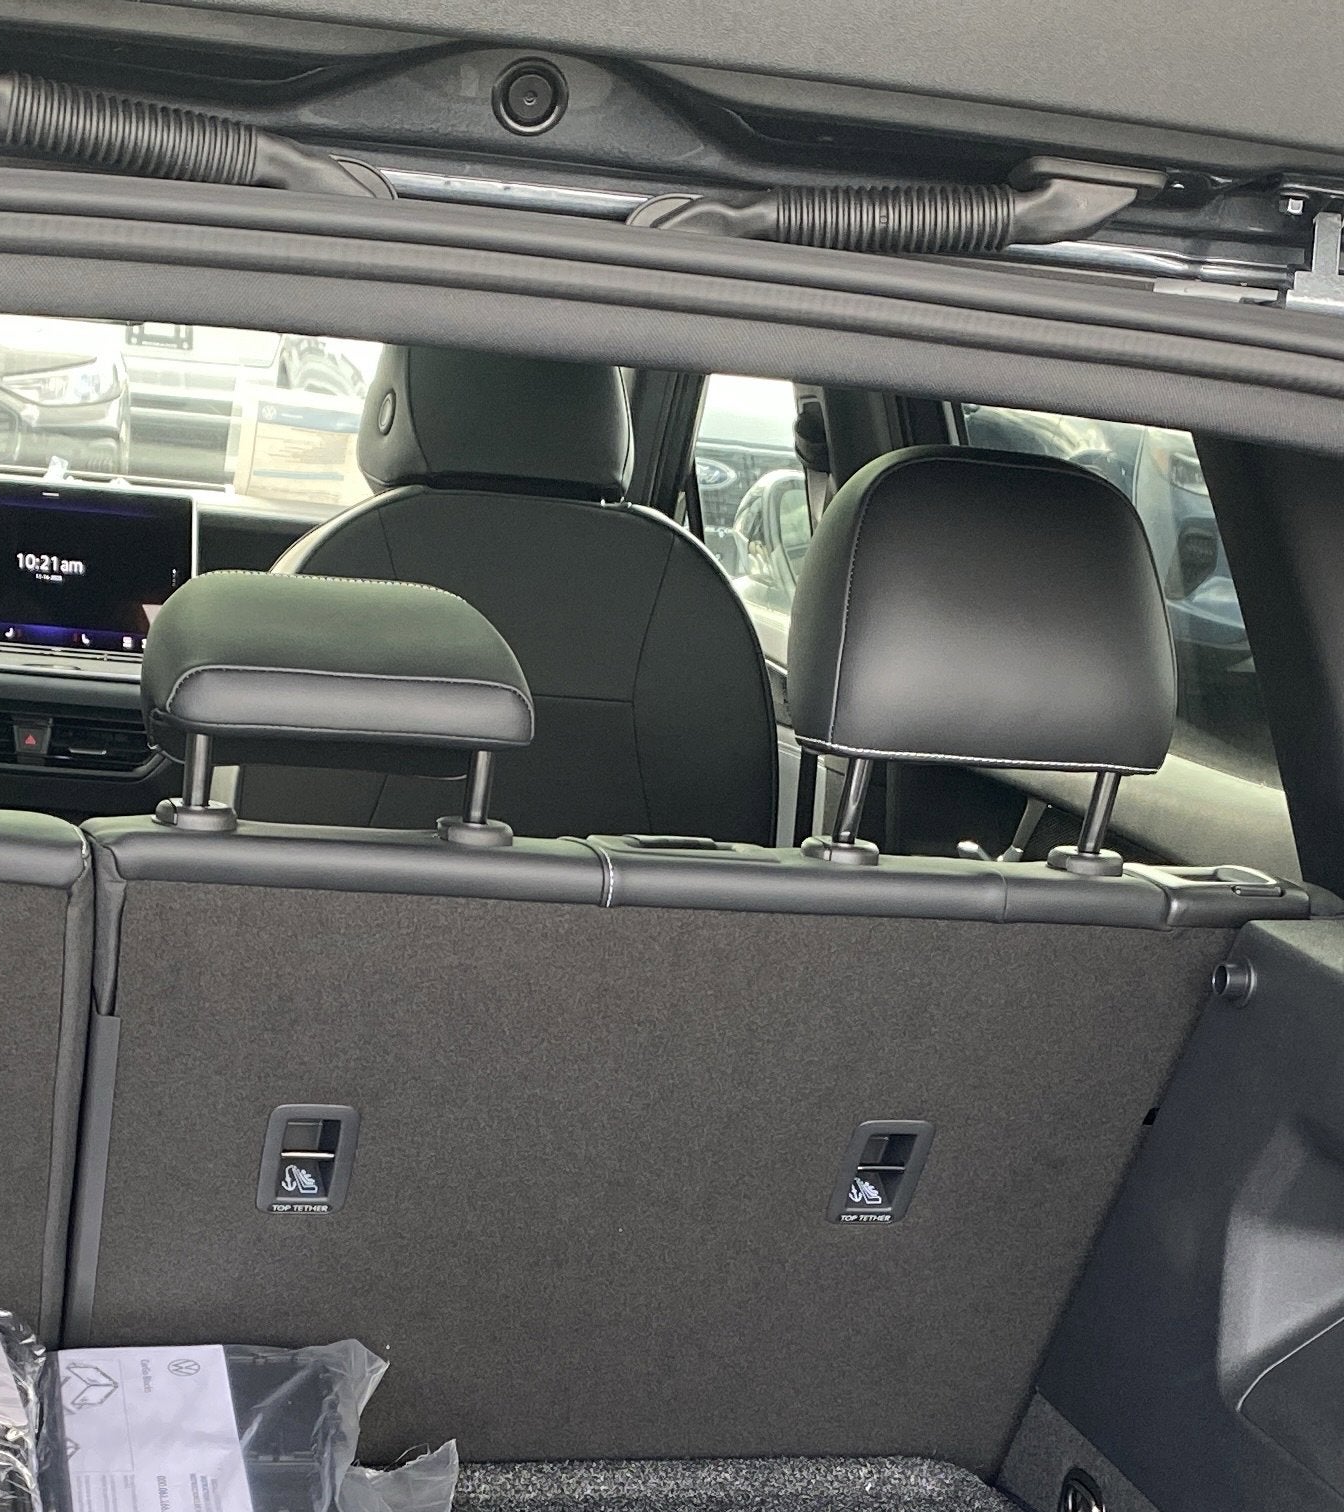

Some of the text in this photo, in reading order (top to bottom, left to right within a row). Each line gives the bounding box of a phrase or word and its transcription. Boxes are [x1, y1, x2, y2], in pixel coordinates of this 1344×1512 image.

[272, 1204, 328, 1212] TOP TETHER
[840, 1214, 892, 1222] TOP TETHER
